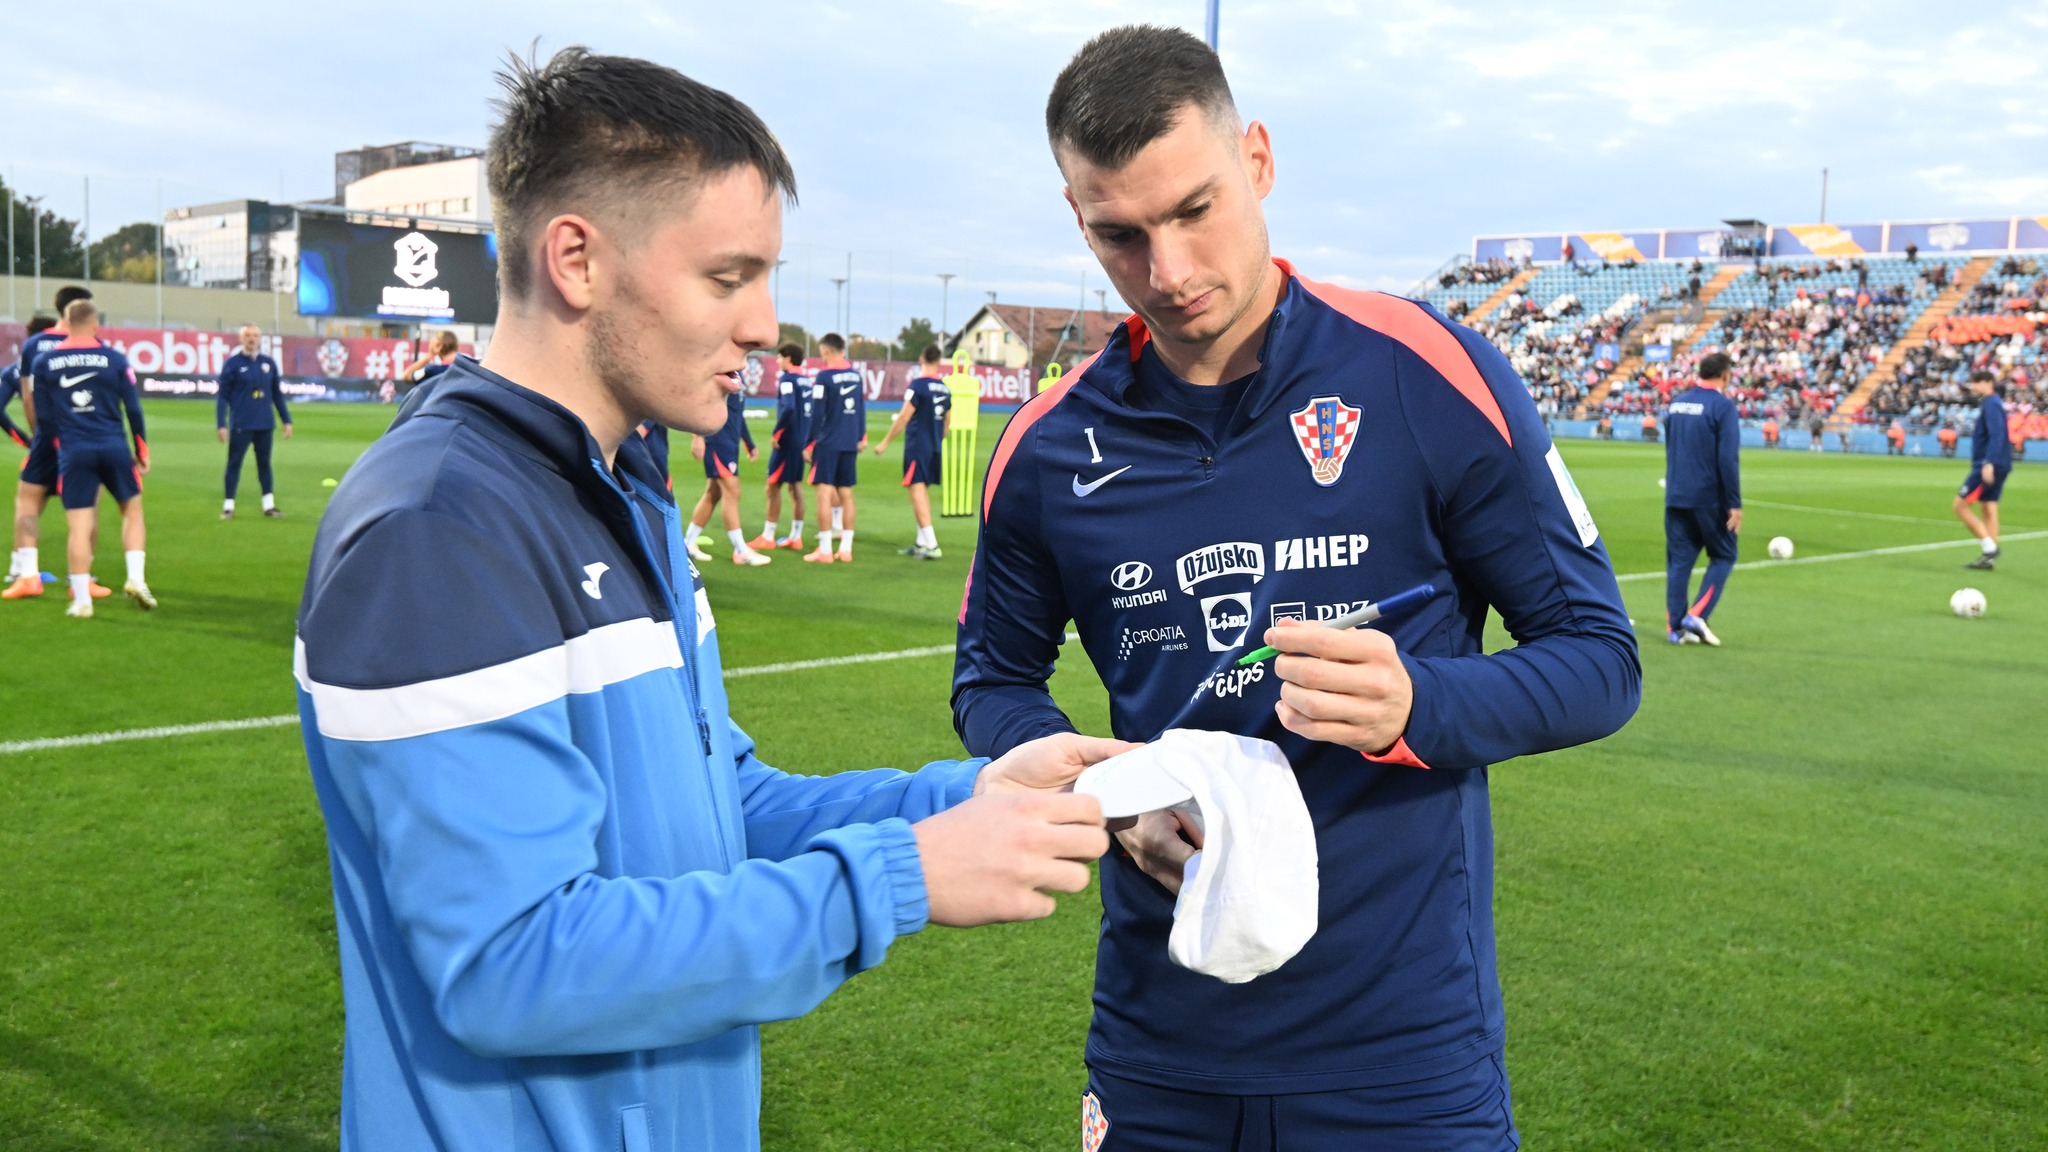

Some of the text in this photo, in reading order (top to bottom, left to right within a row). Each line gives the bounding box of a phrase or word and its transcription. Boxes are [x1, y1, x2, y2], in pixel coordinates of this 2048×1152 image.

[1084, 427, 1103, 464] 1
[1321, 407, 1333, 451] HNS
[1183, 544, 1258, 583] Ožujsko
[1305, 534, 1369, 569] HEP
[1111, 589, 1167, 609] HYUNDAI
[1132, 625, 1186, 645] CROATIA
[1161, 642, 1189, 652] AIRLINES
